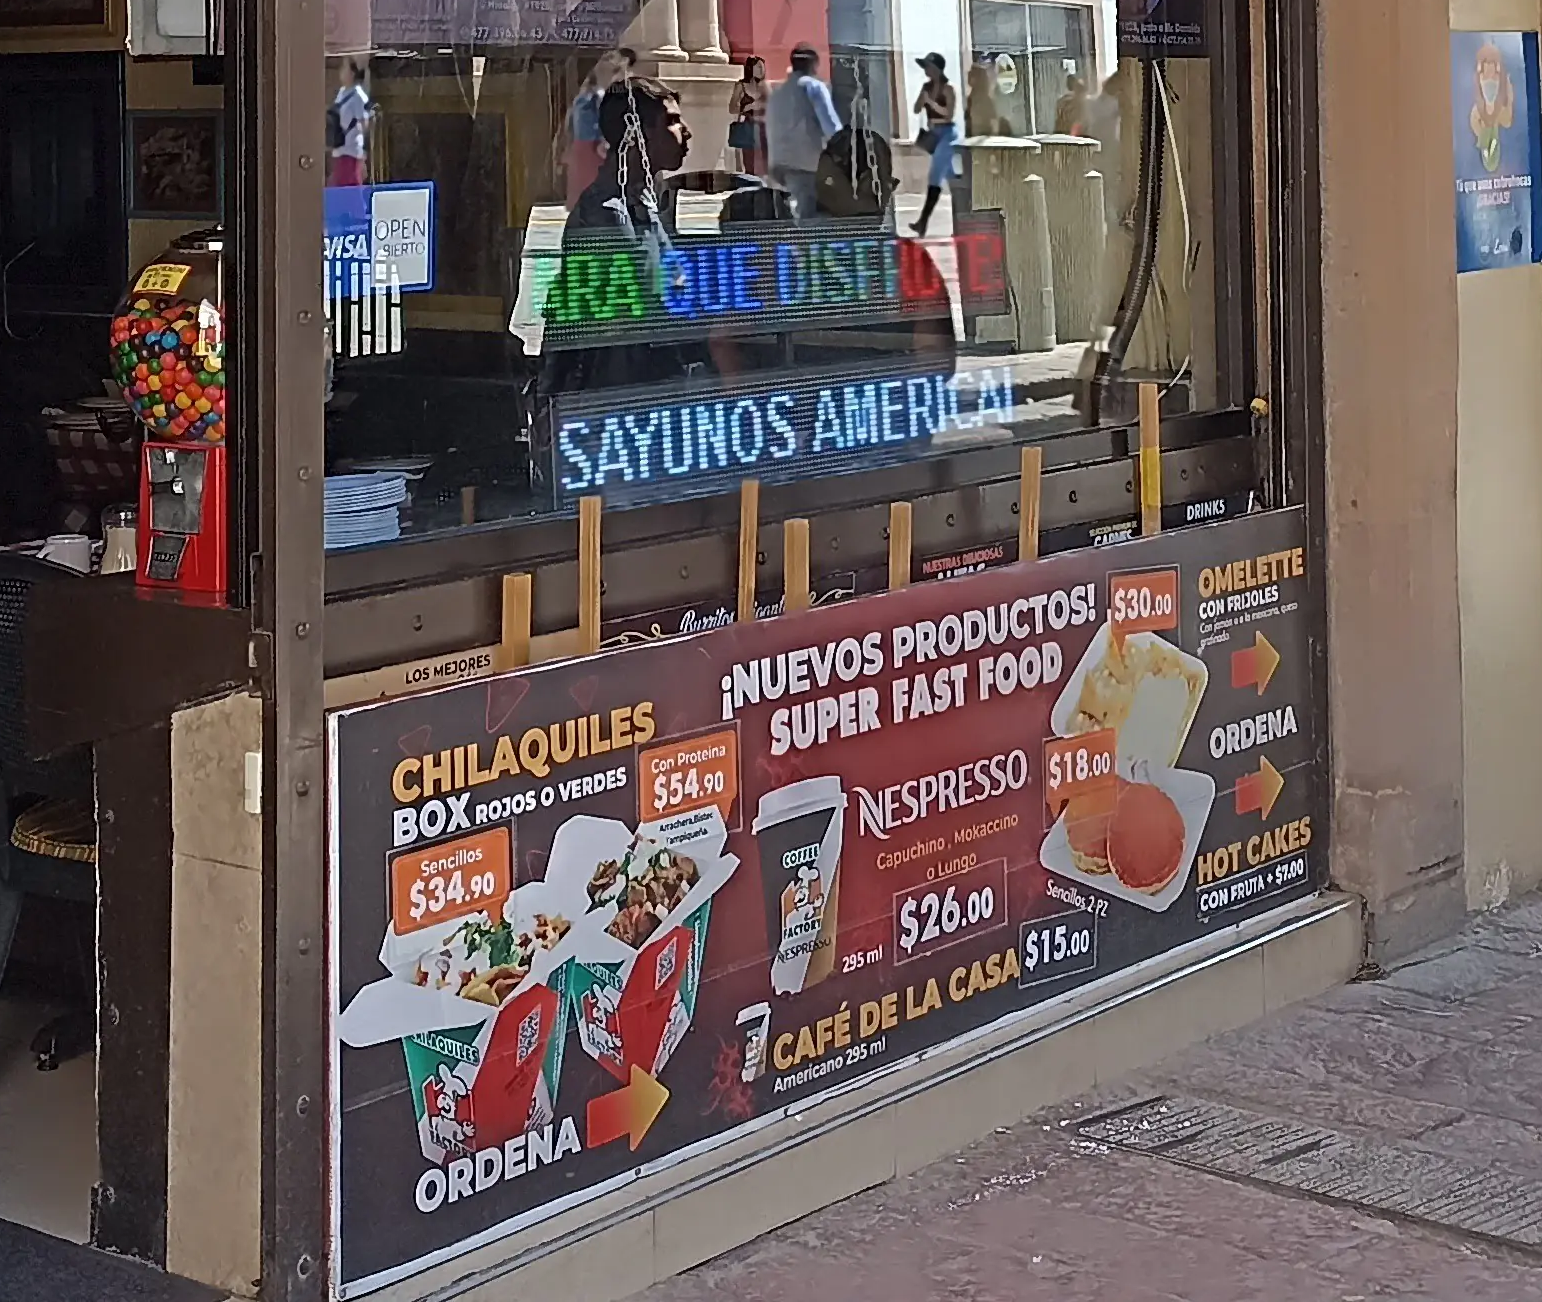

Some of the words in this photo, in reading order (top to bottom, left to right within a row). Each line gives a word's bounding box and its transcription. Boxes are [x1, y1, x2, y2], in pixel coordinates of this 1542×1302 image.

[374, 218, 427, 242] OPEN
[661, 245, 763, 318] QUE
[559, 393, 798, 491] SAYUNOS
[1185, 499, 1227, 522] DRINKS
[1197, 546, 1305, 599] OMELETTE
[1113, 587, 1173, 625] $30.00
[1198, 600, 1226, 621] CON
[1227, 584, 1280, 614] FRIJOLES
[1199, 621, 1214, 635] Con
[404, 664, 432, 686] LOS
[432, 653, 492, 681] MEJORES
[720, 630, 885, 721] ¡NUEVOS
[892, 581, 1098, 672] PRODUCTOS!
[768, 692, 882, 758] SUPER
[892, 664, 966, 725] FAST
[977, 639, 1063, 704] FOOD
[391, 701, 657, 803] CHILAQUILES
[650, 757, 675, 775] Con
[677, 745, 727, 767] Proteína
[1209, 705, 1298, 761] ORDENA
[653, 766, 725, 814] $54.90
[858, 748, 1030, 842] NESPRESSO
[1047, 749, 1113, 792] $18.00
[391, 790, 472, 848] BOX
[474, 790, 537, 826] ROJOS
[540, 787, 555, 808] O
[557, 765, 628, 803] VERDES
[419, 845, 485, 880] Sencillos
[875, 836, 946, 872] Capuchino
[953, 812, 1019, 846] Mokaccino
[937, 849, 978, 880] Lungo
[1196, 842, 1243, 887] HOT
[1246, 817, 1313, 862] CAKES
[408, 869, 496, 924] $34.90
[1199, 887, 1229, 913] CON
[1230, 876, 1265, 904] FRUTA
[1274, 857, 1306, 886] $7.00
[782, 917, 823, 940] FACTORY
[899, 885, 995, 955] $26.00
[776, 937, 833, 964] NESPRESSO
[842, 952, 865, 974] 295
[866, 944, 884, 964] ml
[1024, 924, 1091, 972] $15.00
[772, 1000, 853, 1072] CAFÉ
[858, 1000, 899, 1040] DE
[904, 975, 944, 1023] LA
[947, 946, 1020, 1003] CASA
[773, 1055, 844, 1095] Americano
[845, 1044, 870, 1069] 295
[870, 1035, 887, 1058] ml
[414, 1115, 583, 1215] ORDENA
